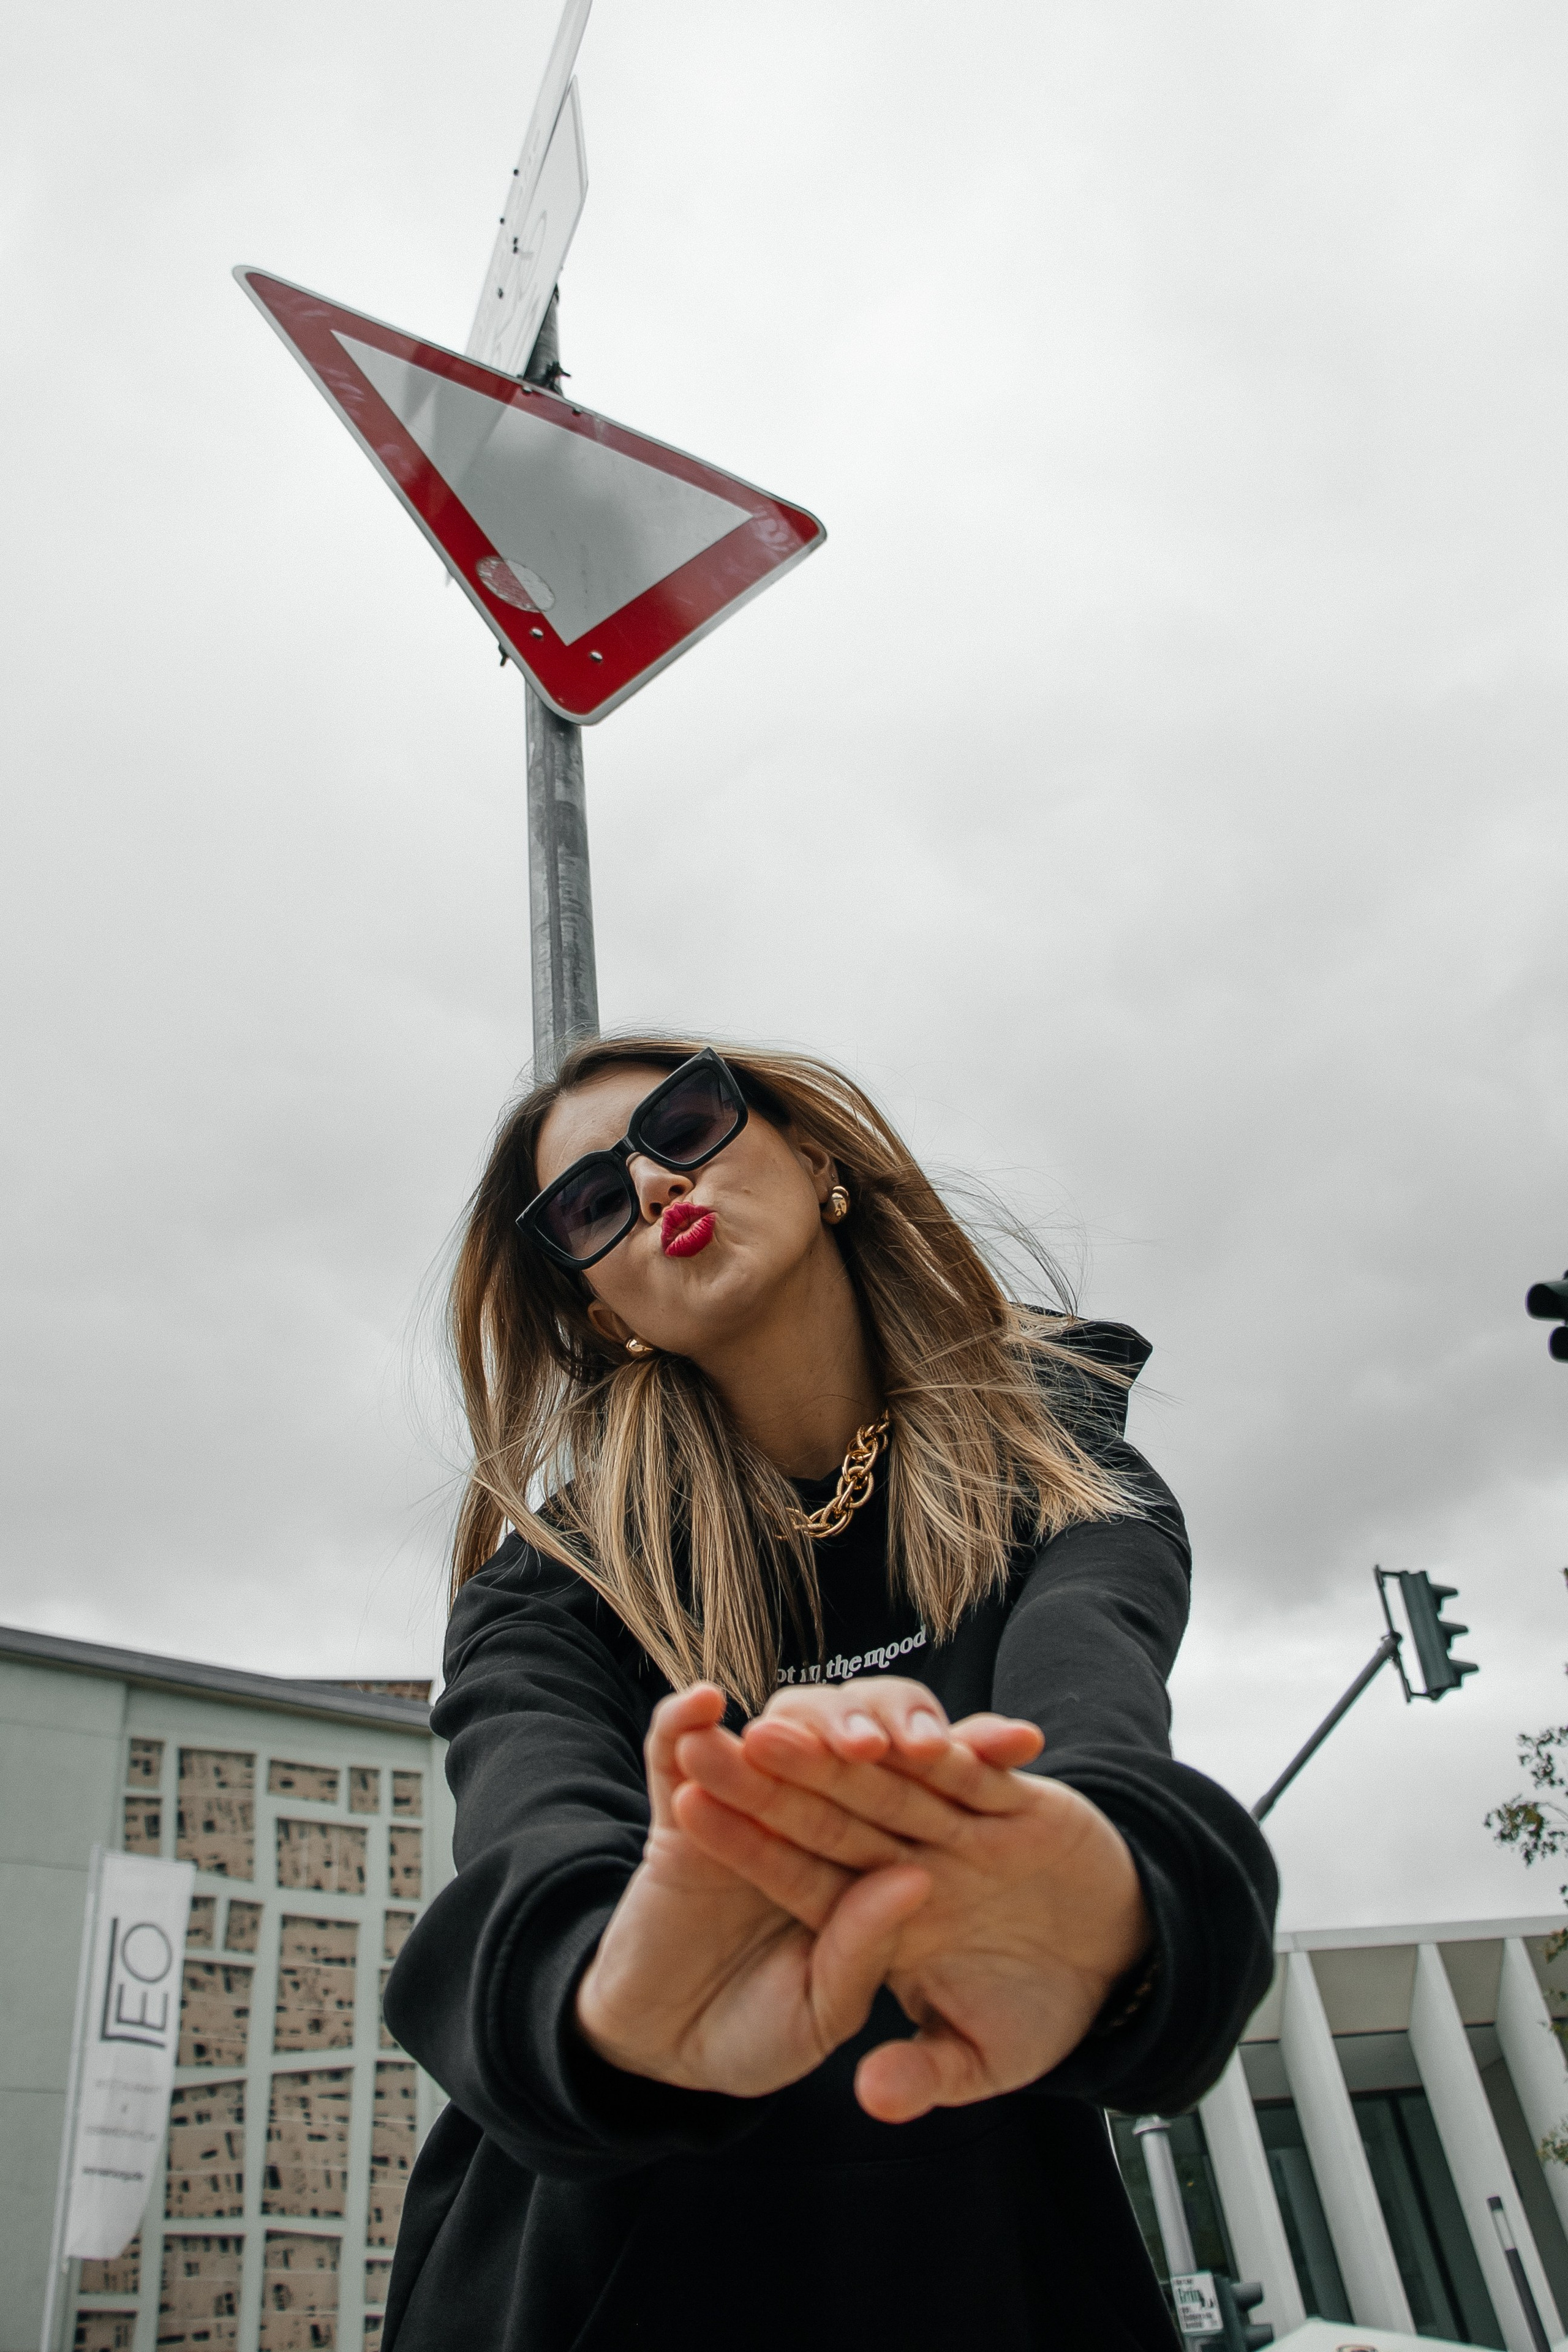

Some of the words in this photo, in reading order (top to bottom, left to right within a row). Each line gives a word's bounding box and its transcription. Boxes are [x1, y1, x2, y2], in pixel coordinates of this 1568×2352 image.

[777, 1665, 796, 1684] ot
[799, 1662, 827, 1684] in
[826, 1654, 862, 1679] the
[863, 1624, 927, 1668] mood
